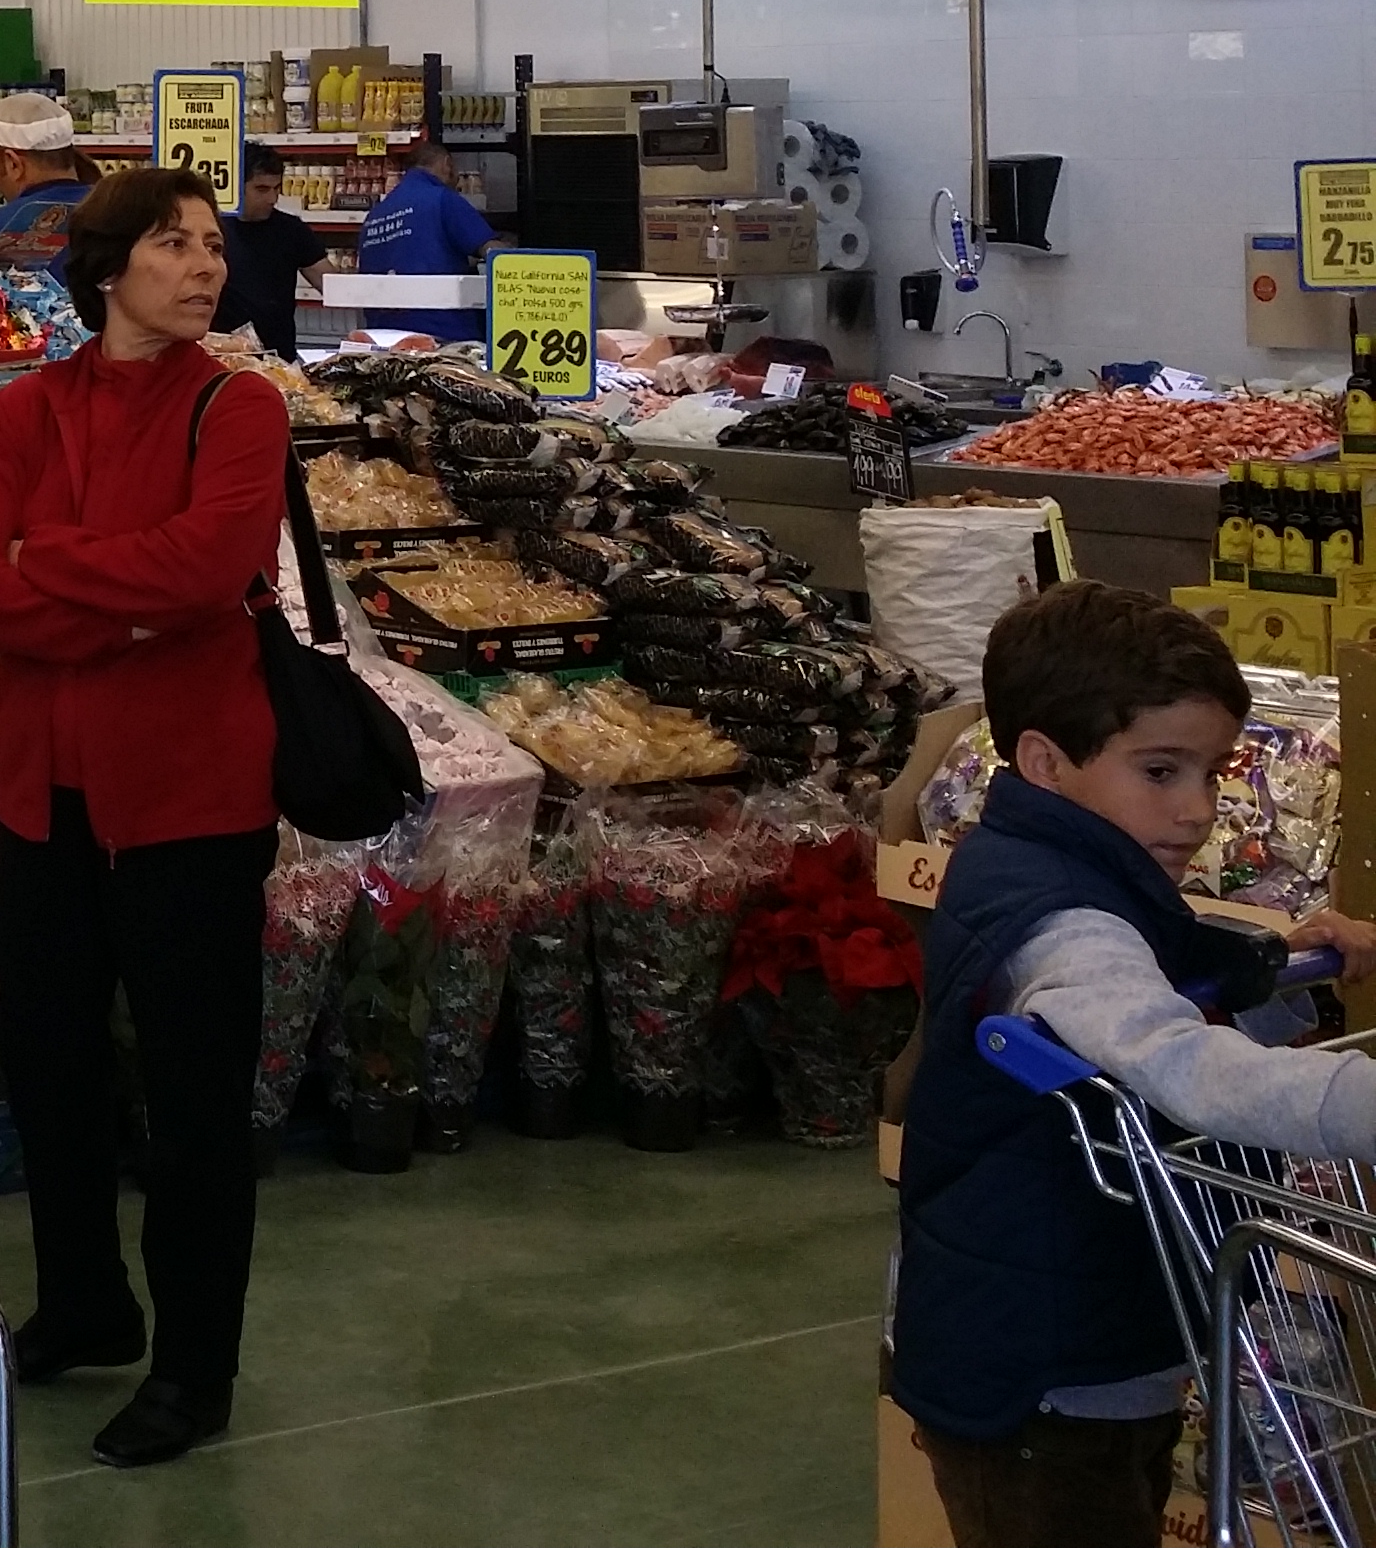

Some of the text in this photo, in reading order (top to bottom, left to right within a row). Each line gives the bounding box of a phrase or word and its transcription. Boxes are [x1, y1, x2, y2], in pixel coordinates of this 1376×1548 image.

[185, 102, 213, 113] FRUTA
[169, 118, 229, 130] ESCARCHADA
[496, 271, 588, 280] Nuez California SAN
[498, 284, 523, 293] BLAS
[550, 299, 565, 308] 500
[533, 372, 570, 383] EUROS
[855, 386, 881, 404] oferta
